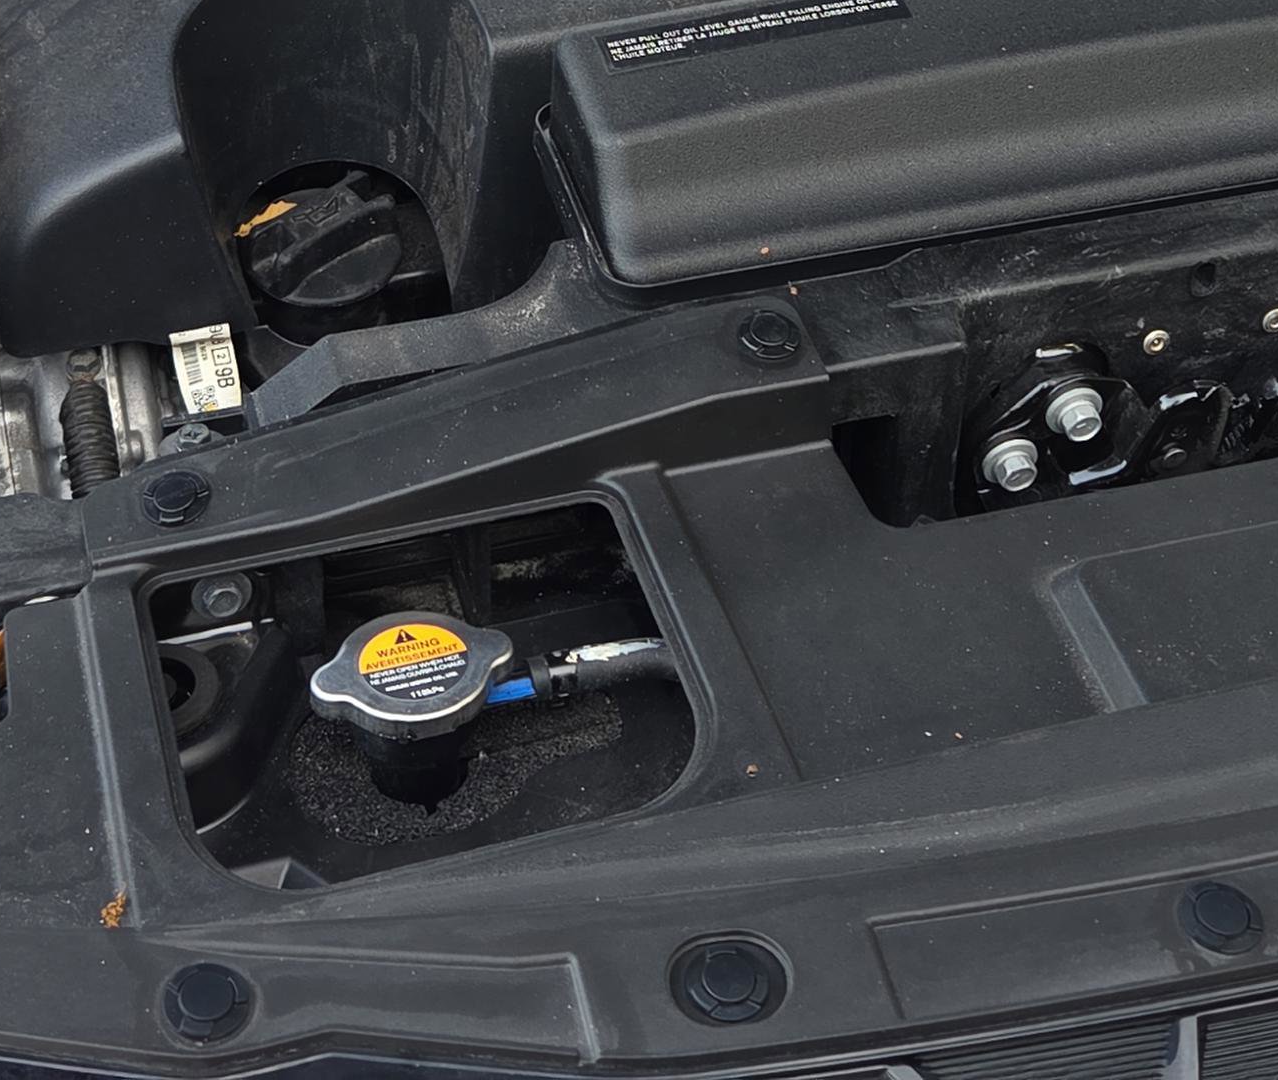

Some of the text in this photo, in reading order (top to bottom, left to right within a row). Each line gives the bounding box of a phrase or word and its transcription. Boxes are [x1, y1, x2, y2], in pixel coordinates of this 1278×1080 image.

[607, 37, 637, 49] NEVER
[639, 33, 661, 43] PULL
[662, 30, 681, 39] OUT
[683, 27, 700, 35] OIL
[700, 22, 727, 32] LEVEL
[727, 16, 759, 27] GAUGE
[760, 11, 787, 22] WHILE
[788, 5, 821, 17] FILLING
[822, 0, 855, 11] ENGINE
[610, 0, 899, 55] NE JAMAIS RETIRER LA JAUGE DE NIVEAU D'HUILE LORSQU'ON VERSE
[613, 51, 645, 61] L'HUILE
[215, 367, 235, 388] 9B
[365, 643, 458, 671] AVERTISSEMENT
[376, 638, 440, 658] WARNING
[369, 667, 396, 679] NEVER
[396, 663, 418, 674] OPEN
[418, 658, 443, 670] WHEN
[381, 673, 406, 684] JAMAIS
